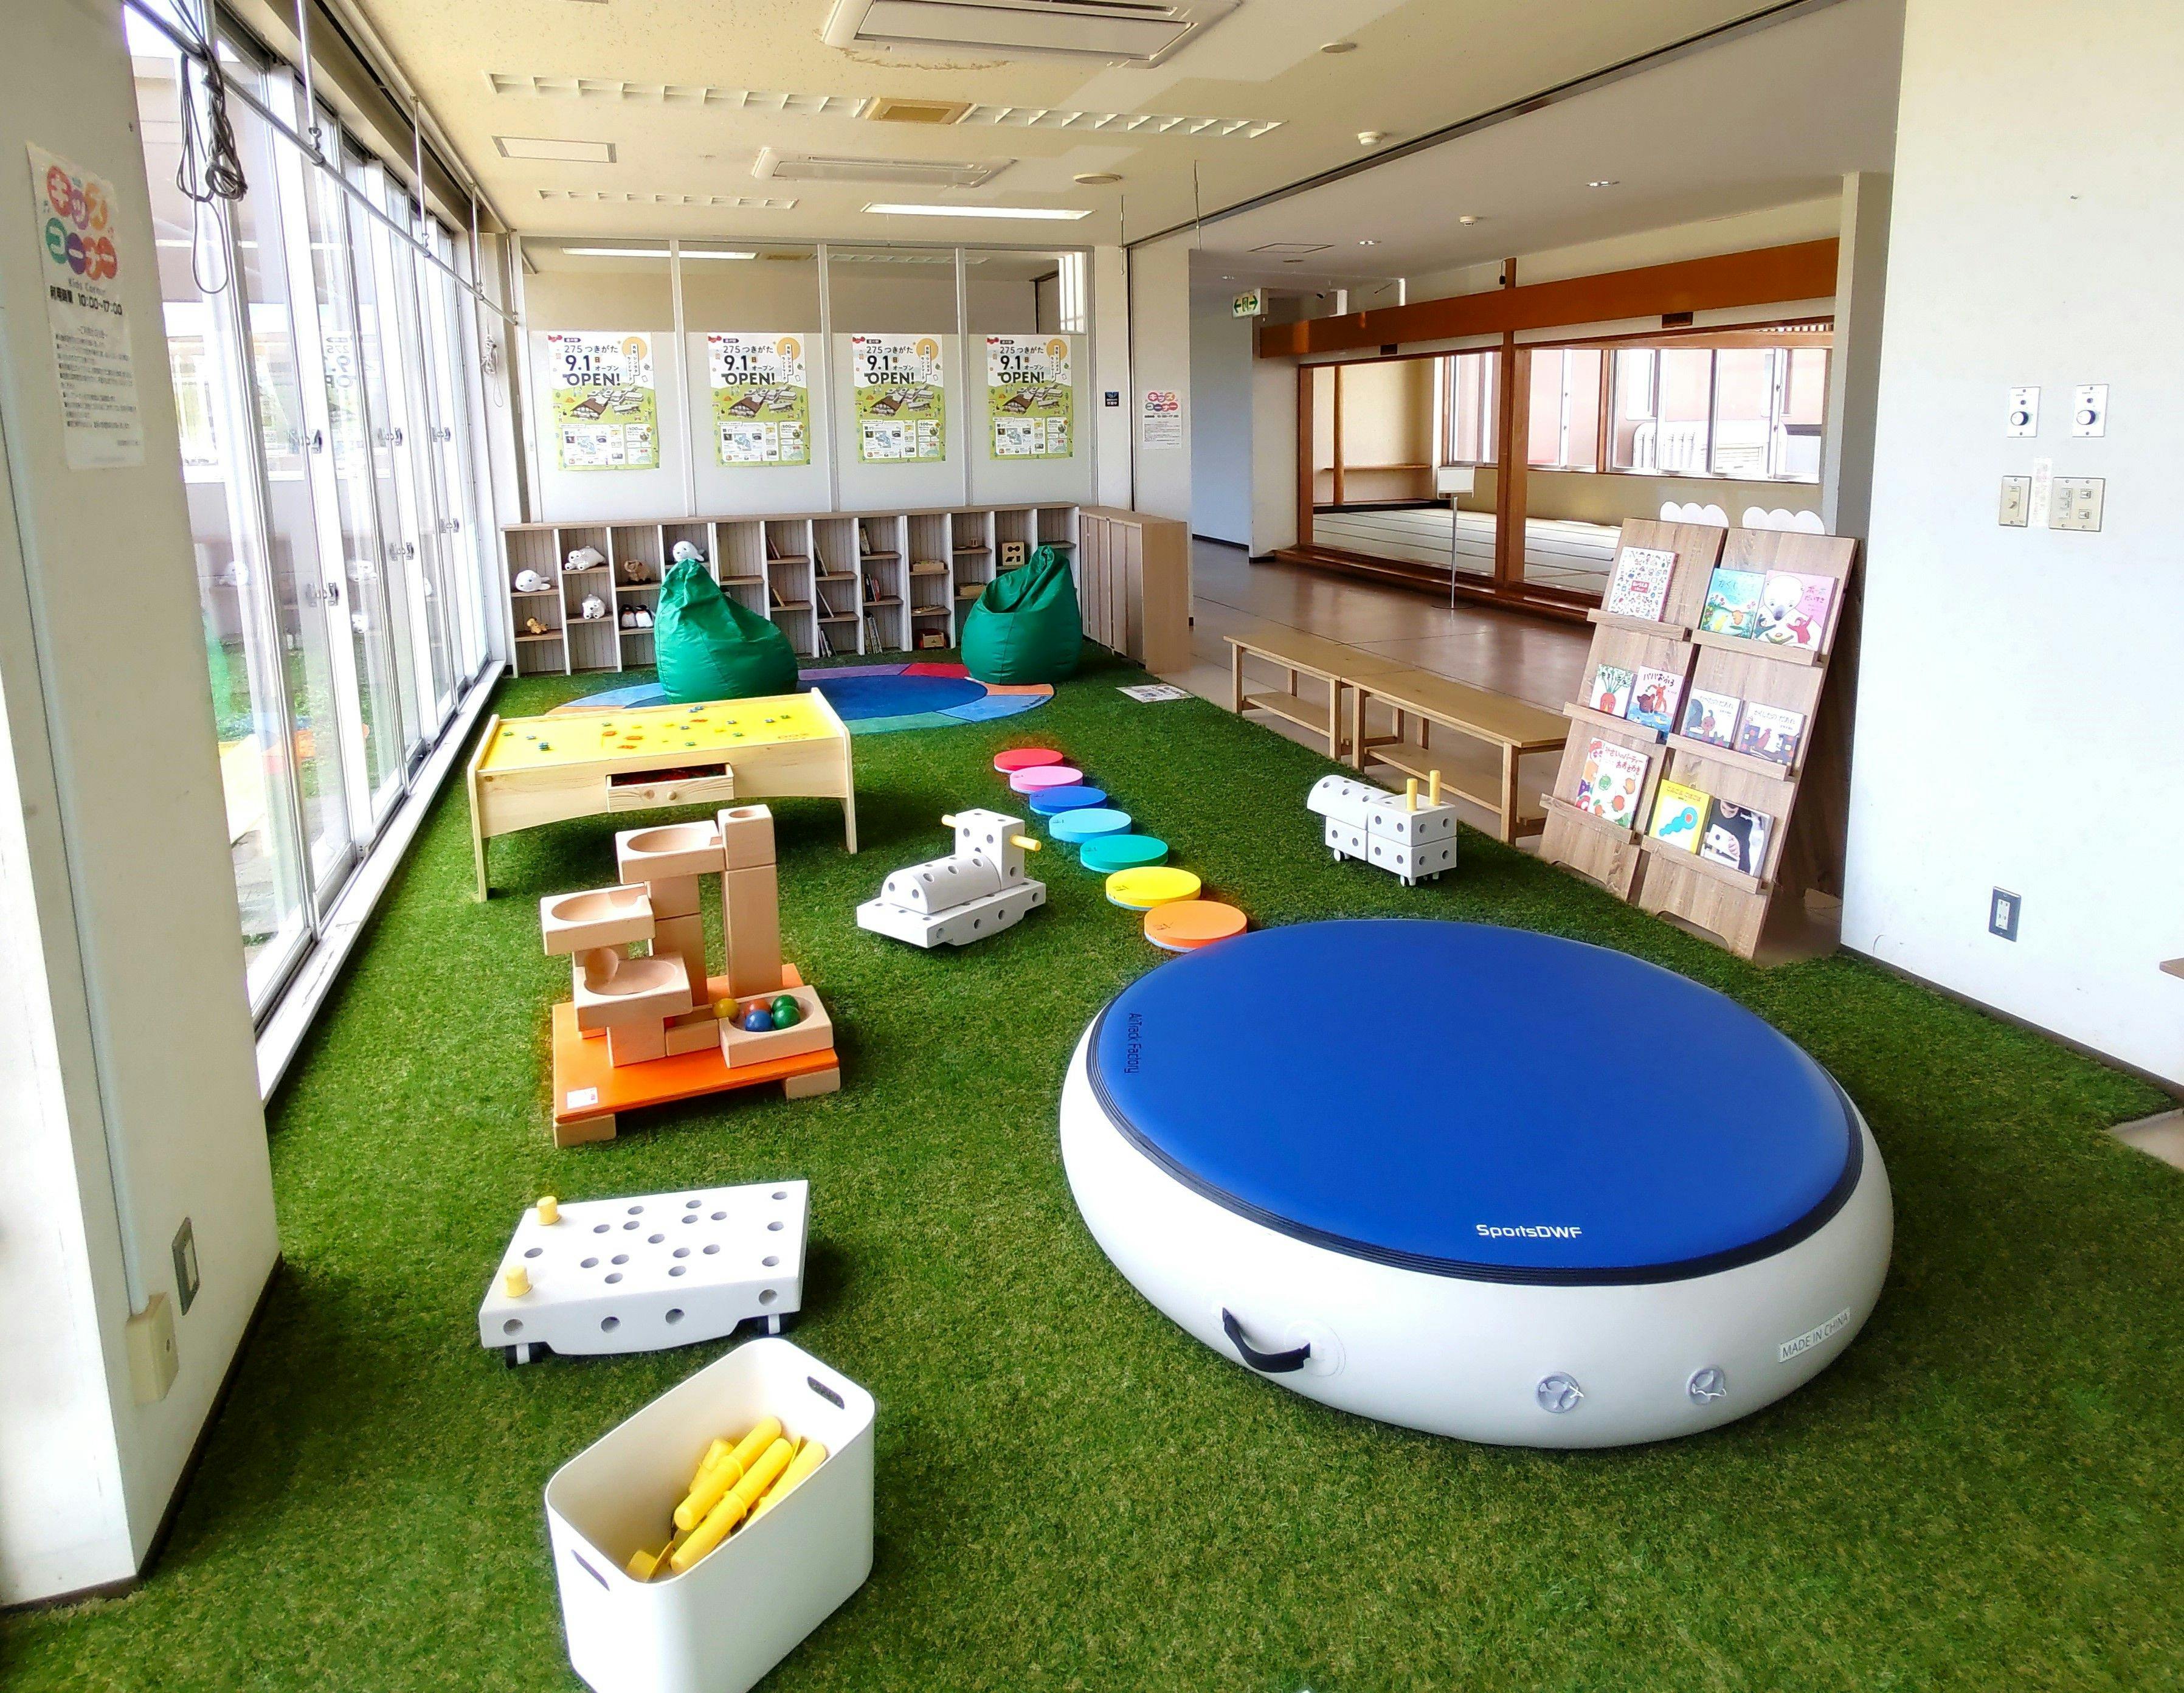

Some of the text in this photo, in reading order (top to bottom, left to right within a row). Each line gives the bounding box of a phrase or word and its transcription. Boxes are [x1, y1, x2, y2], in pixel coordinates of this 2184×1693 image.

[565, 355, 590, 371] 9.1
[724, 355, 747, 371] 9.1
[867, 355, 888, 371] 9.1
[1000, 355, 1021, 370] 9.1
[562, 373, 620, 386] OPEN!
[721, 373, 775, 385] OPEN!
[864, 372, 914, 384] OPEN!
[997, 372, 1045, 384] OPEN!
[1124, 1043, 1142, 1074] Factory
[1476, 1224, 1583, 1239] SportsDWF
[1782, 1312, 1848, 1358] MADE IN CHINA
